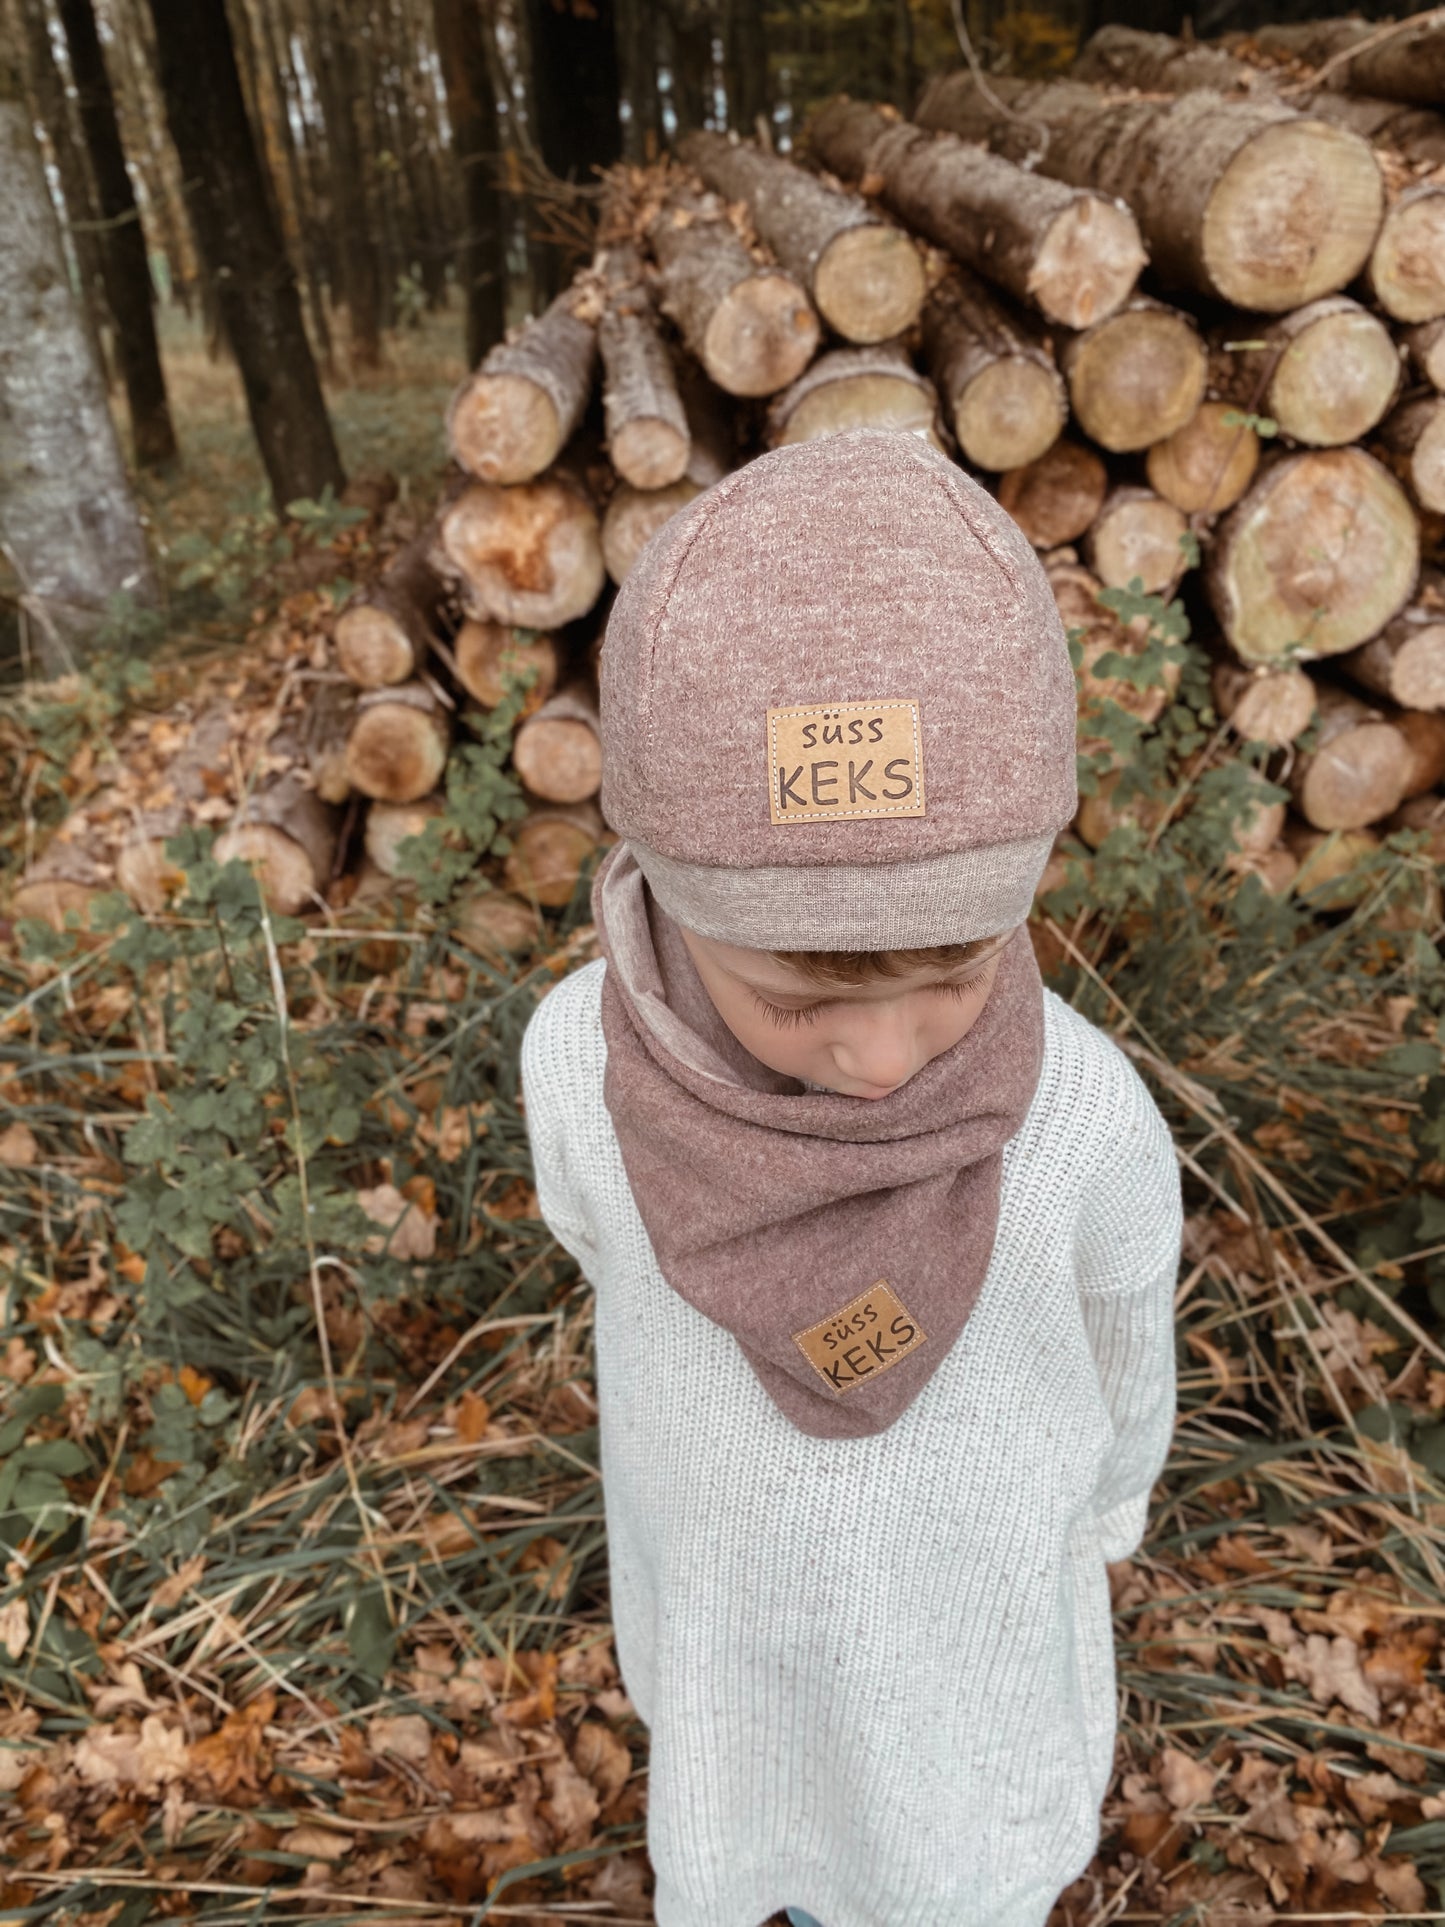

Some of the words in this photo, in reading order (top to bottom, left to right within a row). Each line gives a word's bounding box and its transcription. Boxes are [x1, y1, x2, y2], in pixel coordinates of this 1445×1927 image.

[801, 713, 883, 749] süss
[779, 758, 913, 810] KEKS
[822, 1303, 878, 1350] süss
[822, 1315, 915, 1388] KEKS
